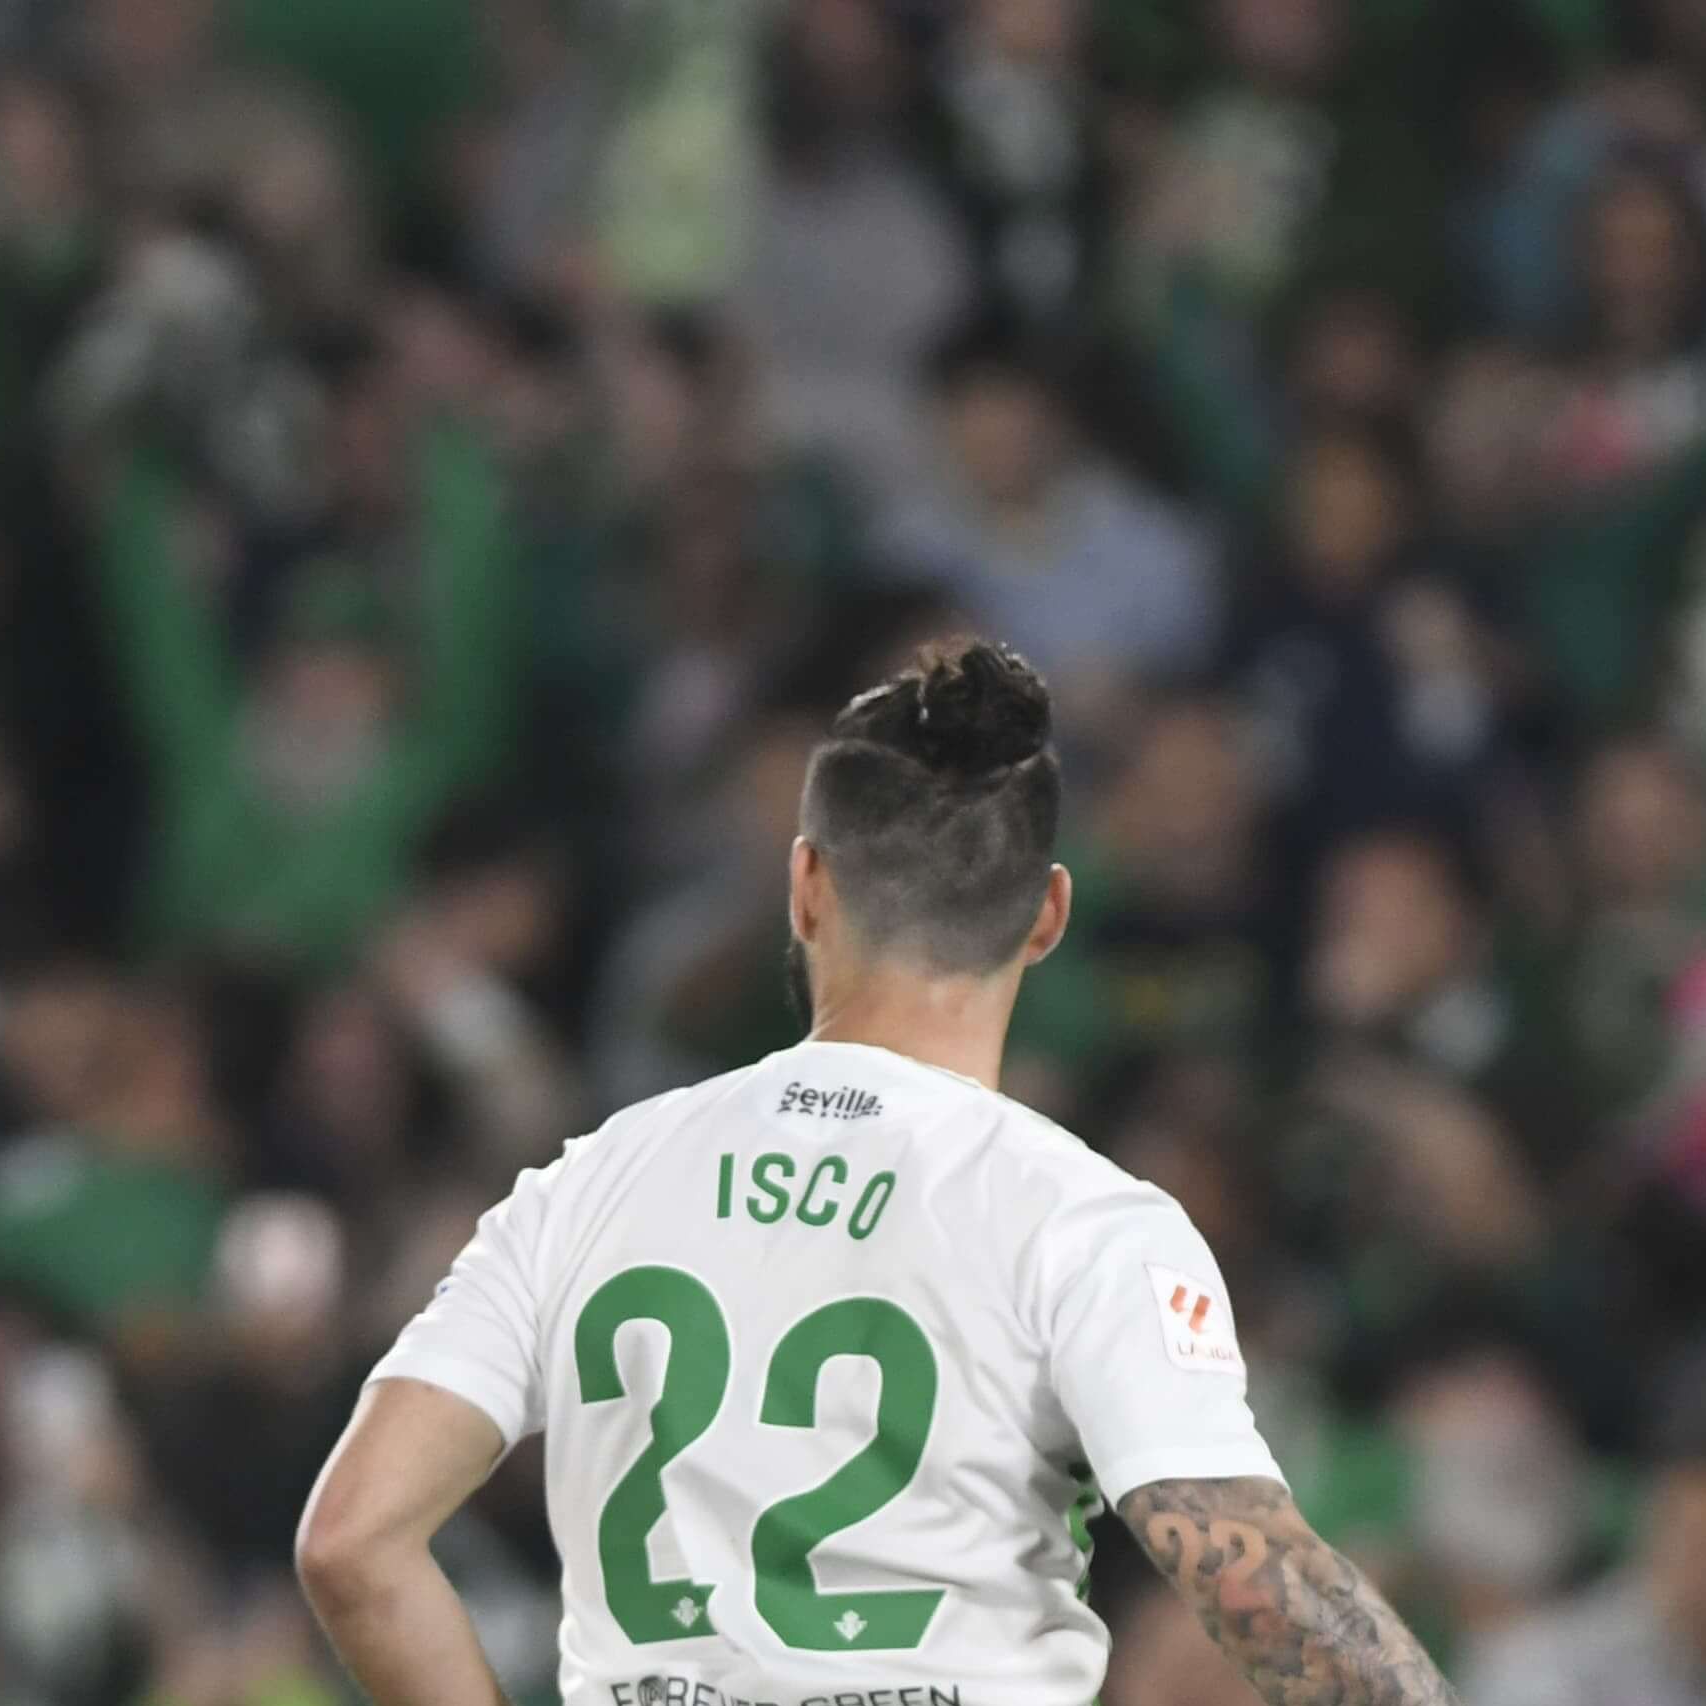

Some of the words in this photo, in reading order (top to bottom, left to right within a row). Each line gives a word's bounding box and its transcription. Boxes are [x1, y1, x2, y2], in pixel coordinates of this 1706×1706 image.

[779, 1080, 881, 1116] Sevilla
[716, 1151, 897, 1242] ISCO
[574, 1264, 946, 1652] 22
